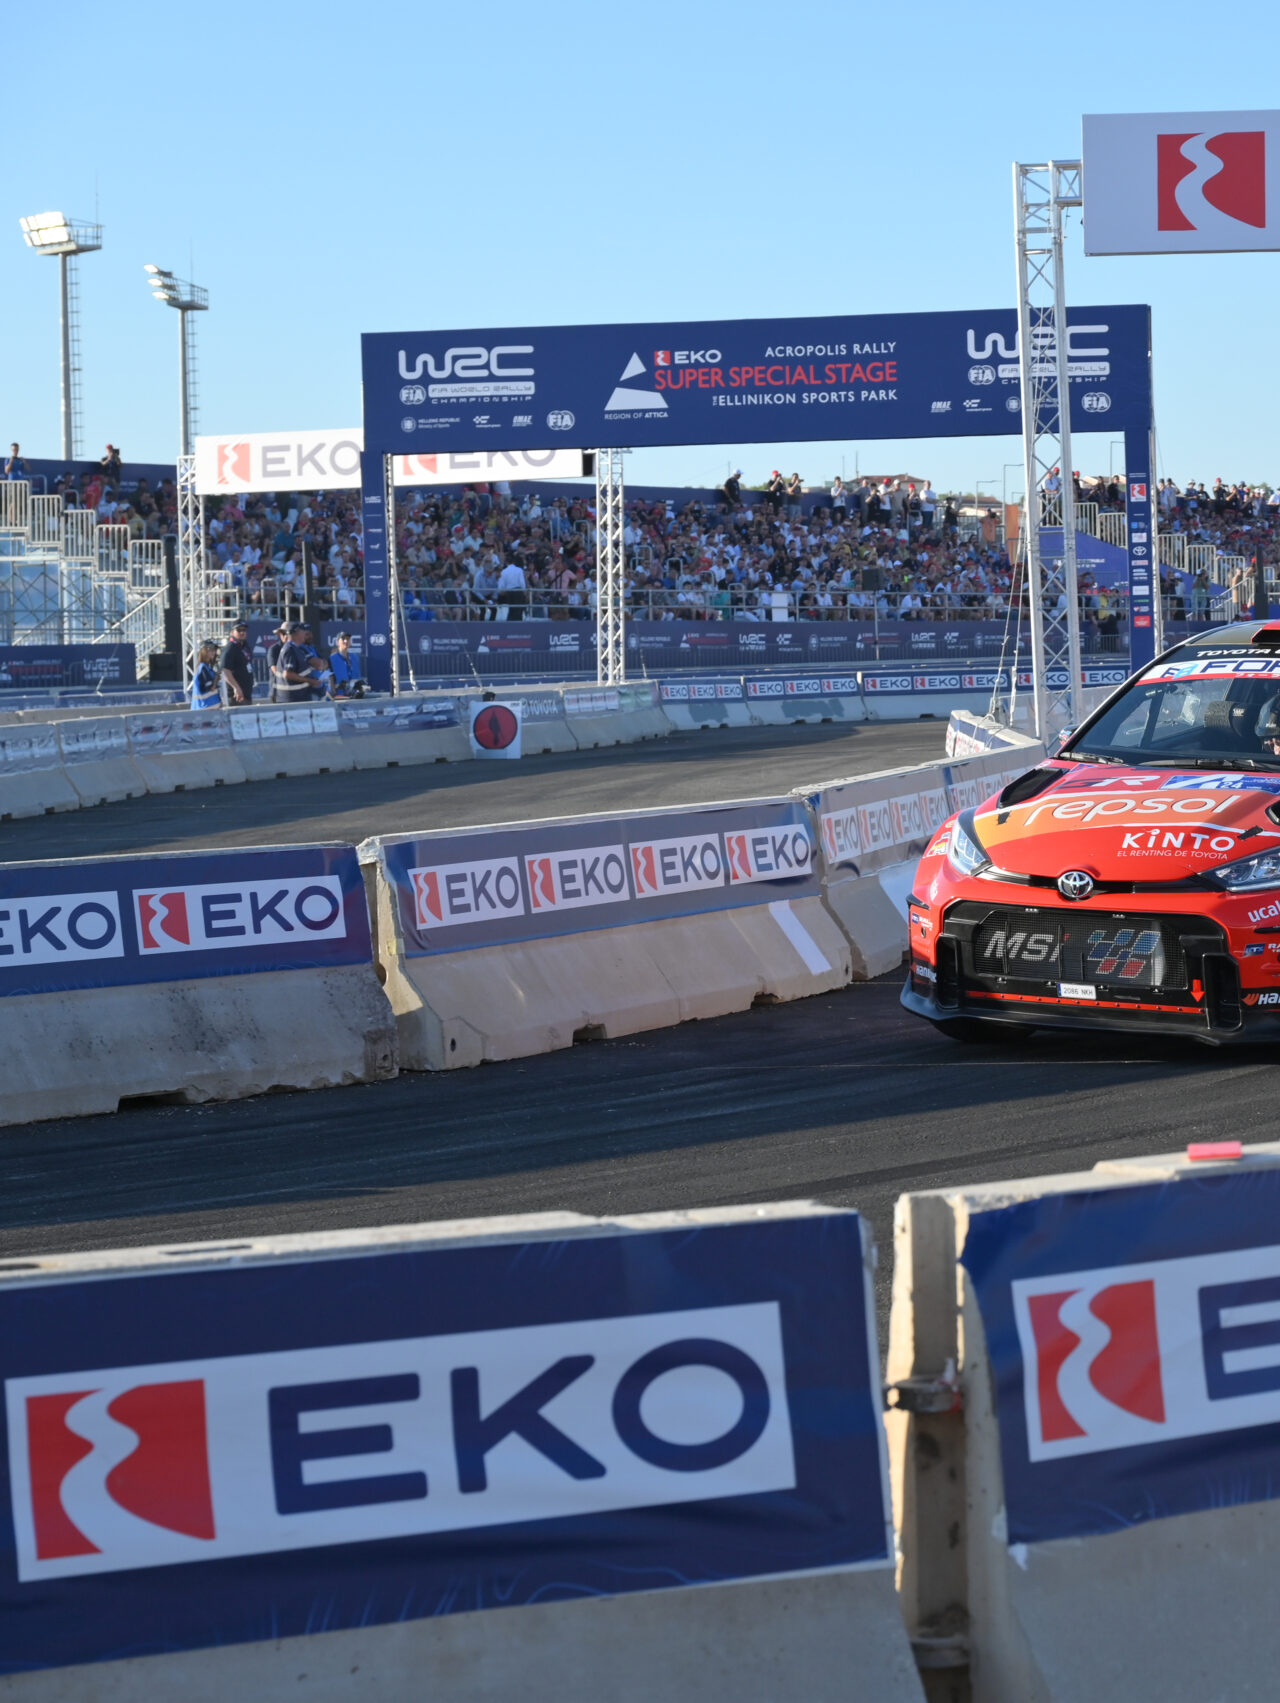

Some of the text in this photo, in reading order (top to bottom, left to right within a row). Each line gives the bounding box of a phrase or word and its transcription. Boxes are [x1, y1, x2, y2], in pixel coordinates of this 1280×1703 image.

[674, 349, 722, 365] EKO
[765, 341, 897, 358] ACROPOLIS RALLY
[398, 345, 535, 380] WRC
[654, 361, 898, 390] SUPER SPECIAL STAGE
[969, 366, 995, 384] FIA
[431, 396, 532, 405] CHAMPIONSHIP
[718, 388, 898, 407] ELLINIKON SPORTS PARK
[1083, 393, 1110, 411] FIA
[548, 411, 573, 428] FIA
[262, 439, 361, 479] EKO
[550, 633, 579, 645] WRC
[739, 633, 766, 644] WRC
[1197, 649, 1270, 658] TOYOTA
[759, 678, 856, 694] EKO EKO EKO
[880, 674, 1007, 690] EKO EKO EKO
[1045, 671, 1124, 685] KO EKO
[670, 686, 741, 698] EKO EKO EKO
[1221, 781, 1243, 790] 24
[1024, 795, 1243, 826] repsol
[834, 814, 859, 851] EKO
[869, 807, 893, 843] EKO
[901, 802, 921, 838] EKO
[1116, 849, 1228, 861] EL RENTING DE TOYOTA
[445, 831, 810, 916] EKO EKO EKO EKO
[200, 884, 340, 939] EKO
[1081, 987, 1094, 997] NKH
[267, 1337, 772, 1517] EKO
